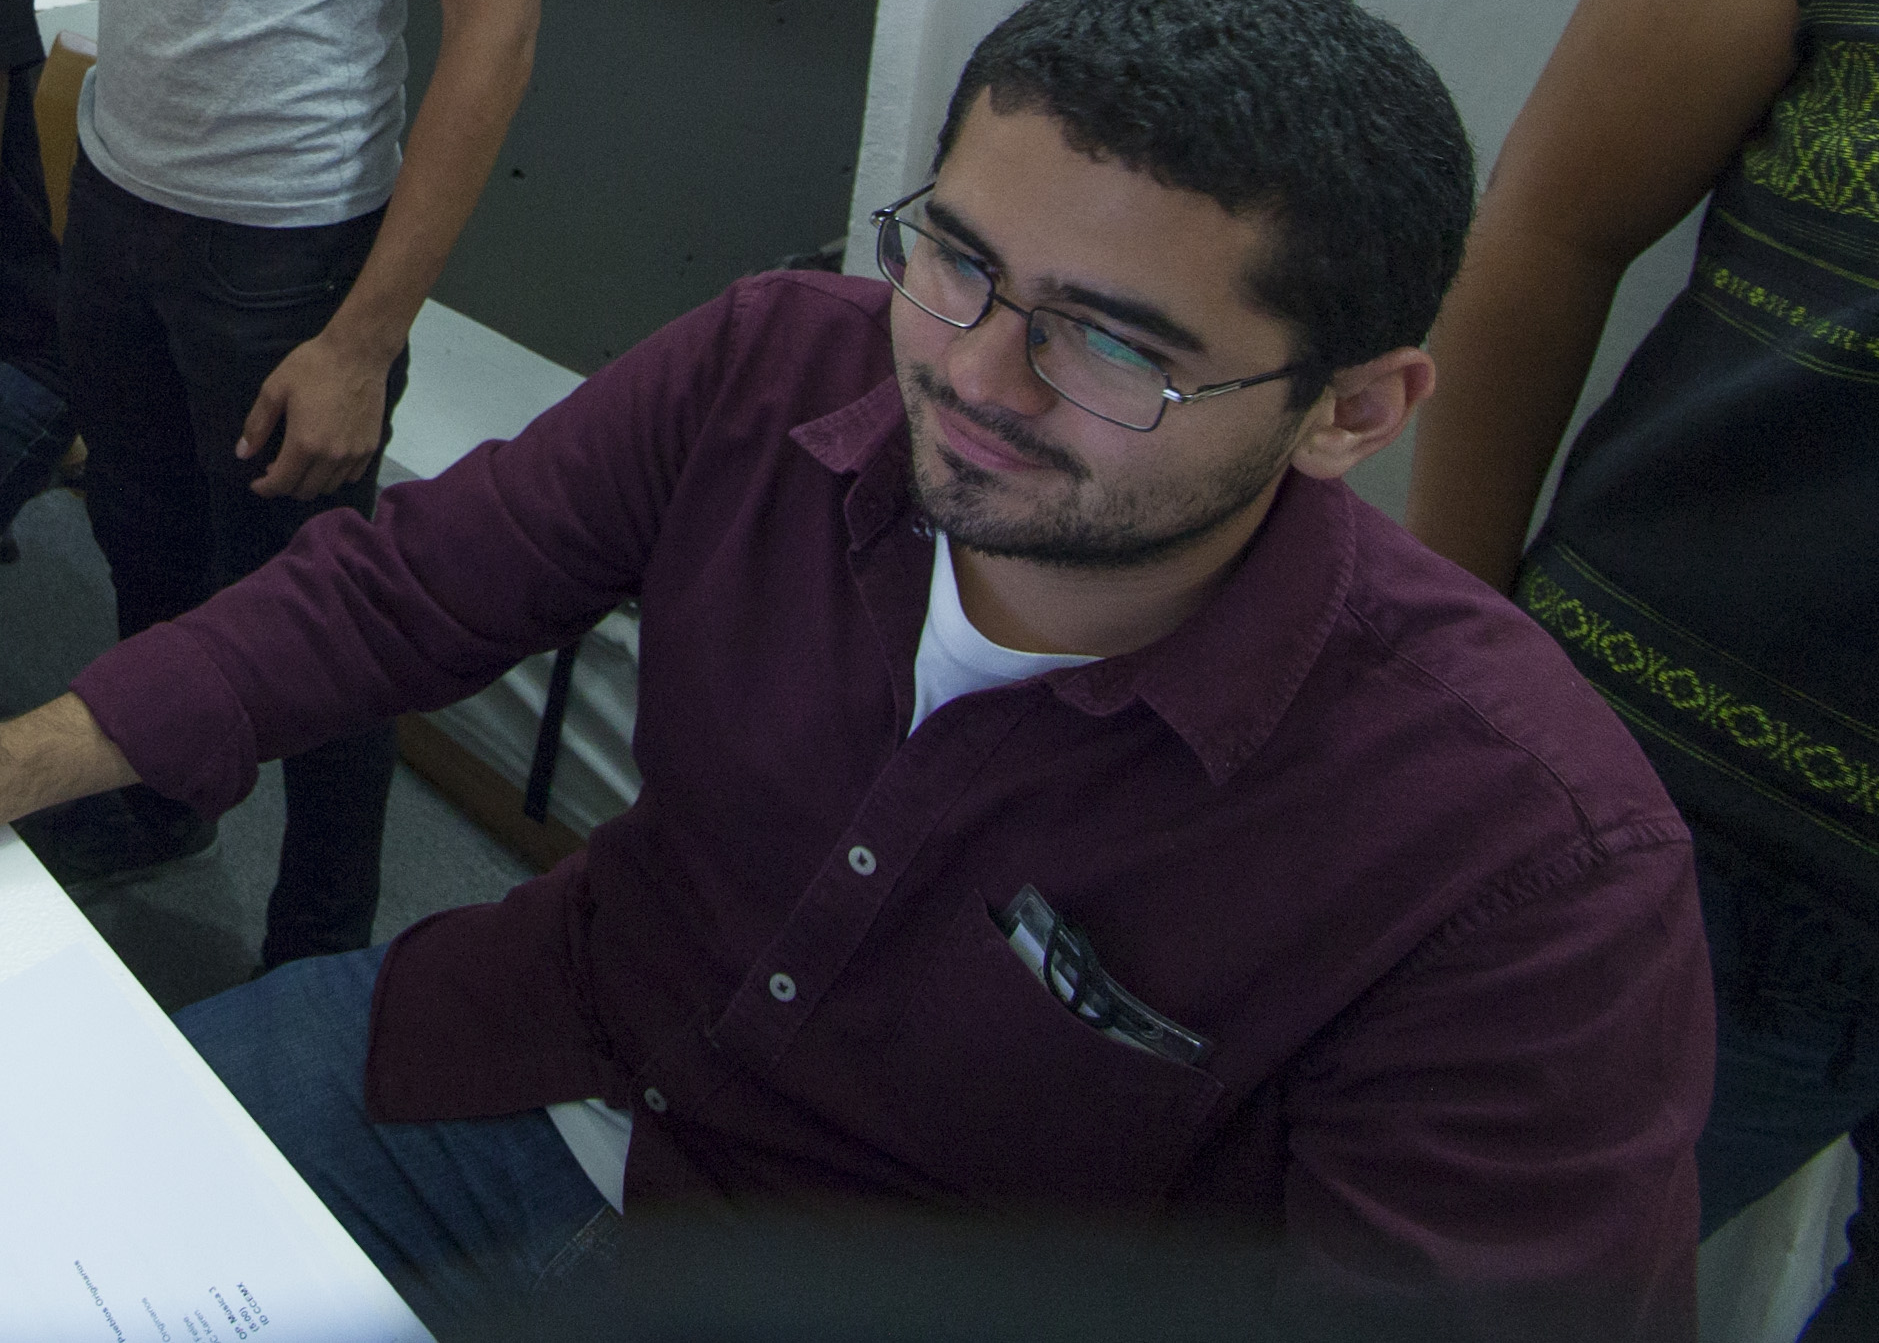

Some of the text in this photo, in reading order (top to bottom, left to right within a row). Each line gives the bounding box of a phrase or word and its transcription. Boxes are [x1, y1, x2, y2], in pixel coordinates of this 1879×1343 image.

[74, 1259, 126, 1343] Pueblos Originarios
[236, 1281, 262, 1315] CCEMX
[194, 1309, 213, 1336] Karen
